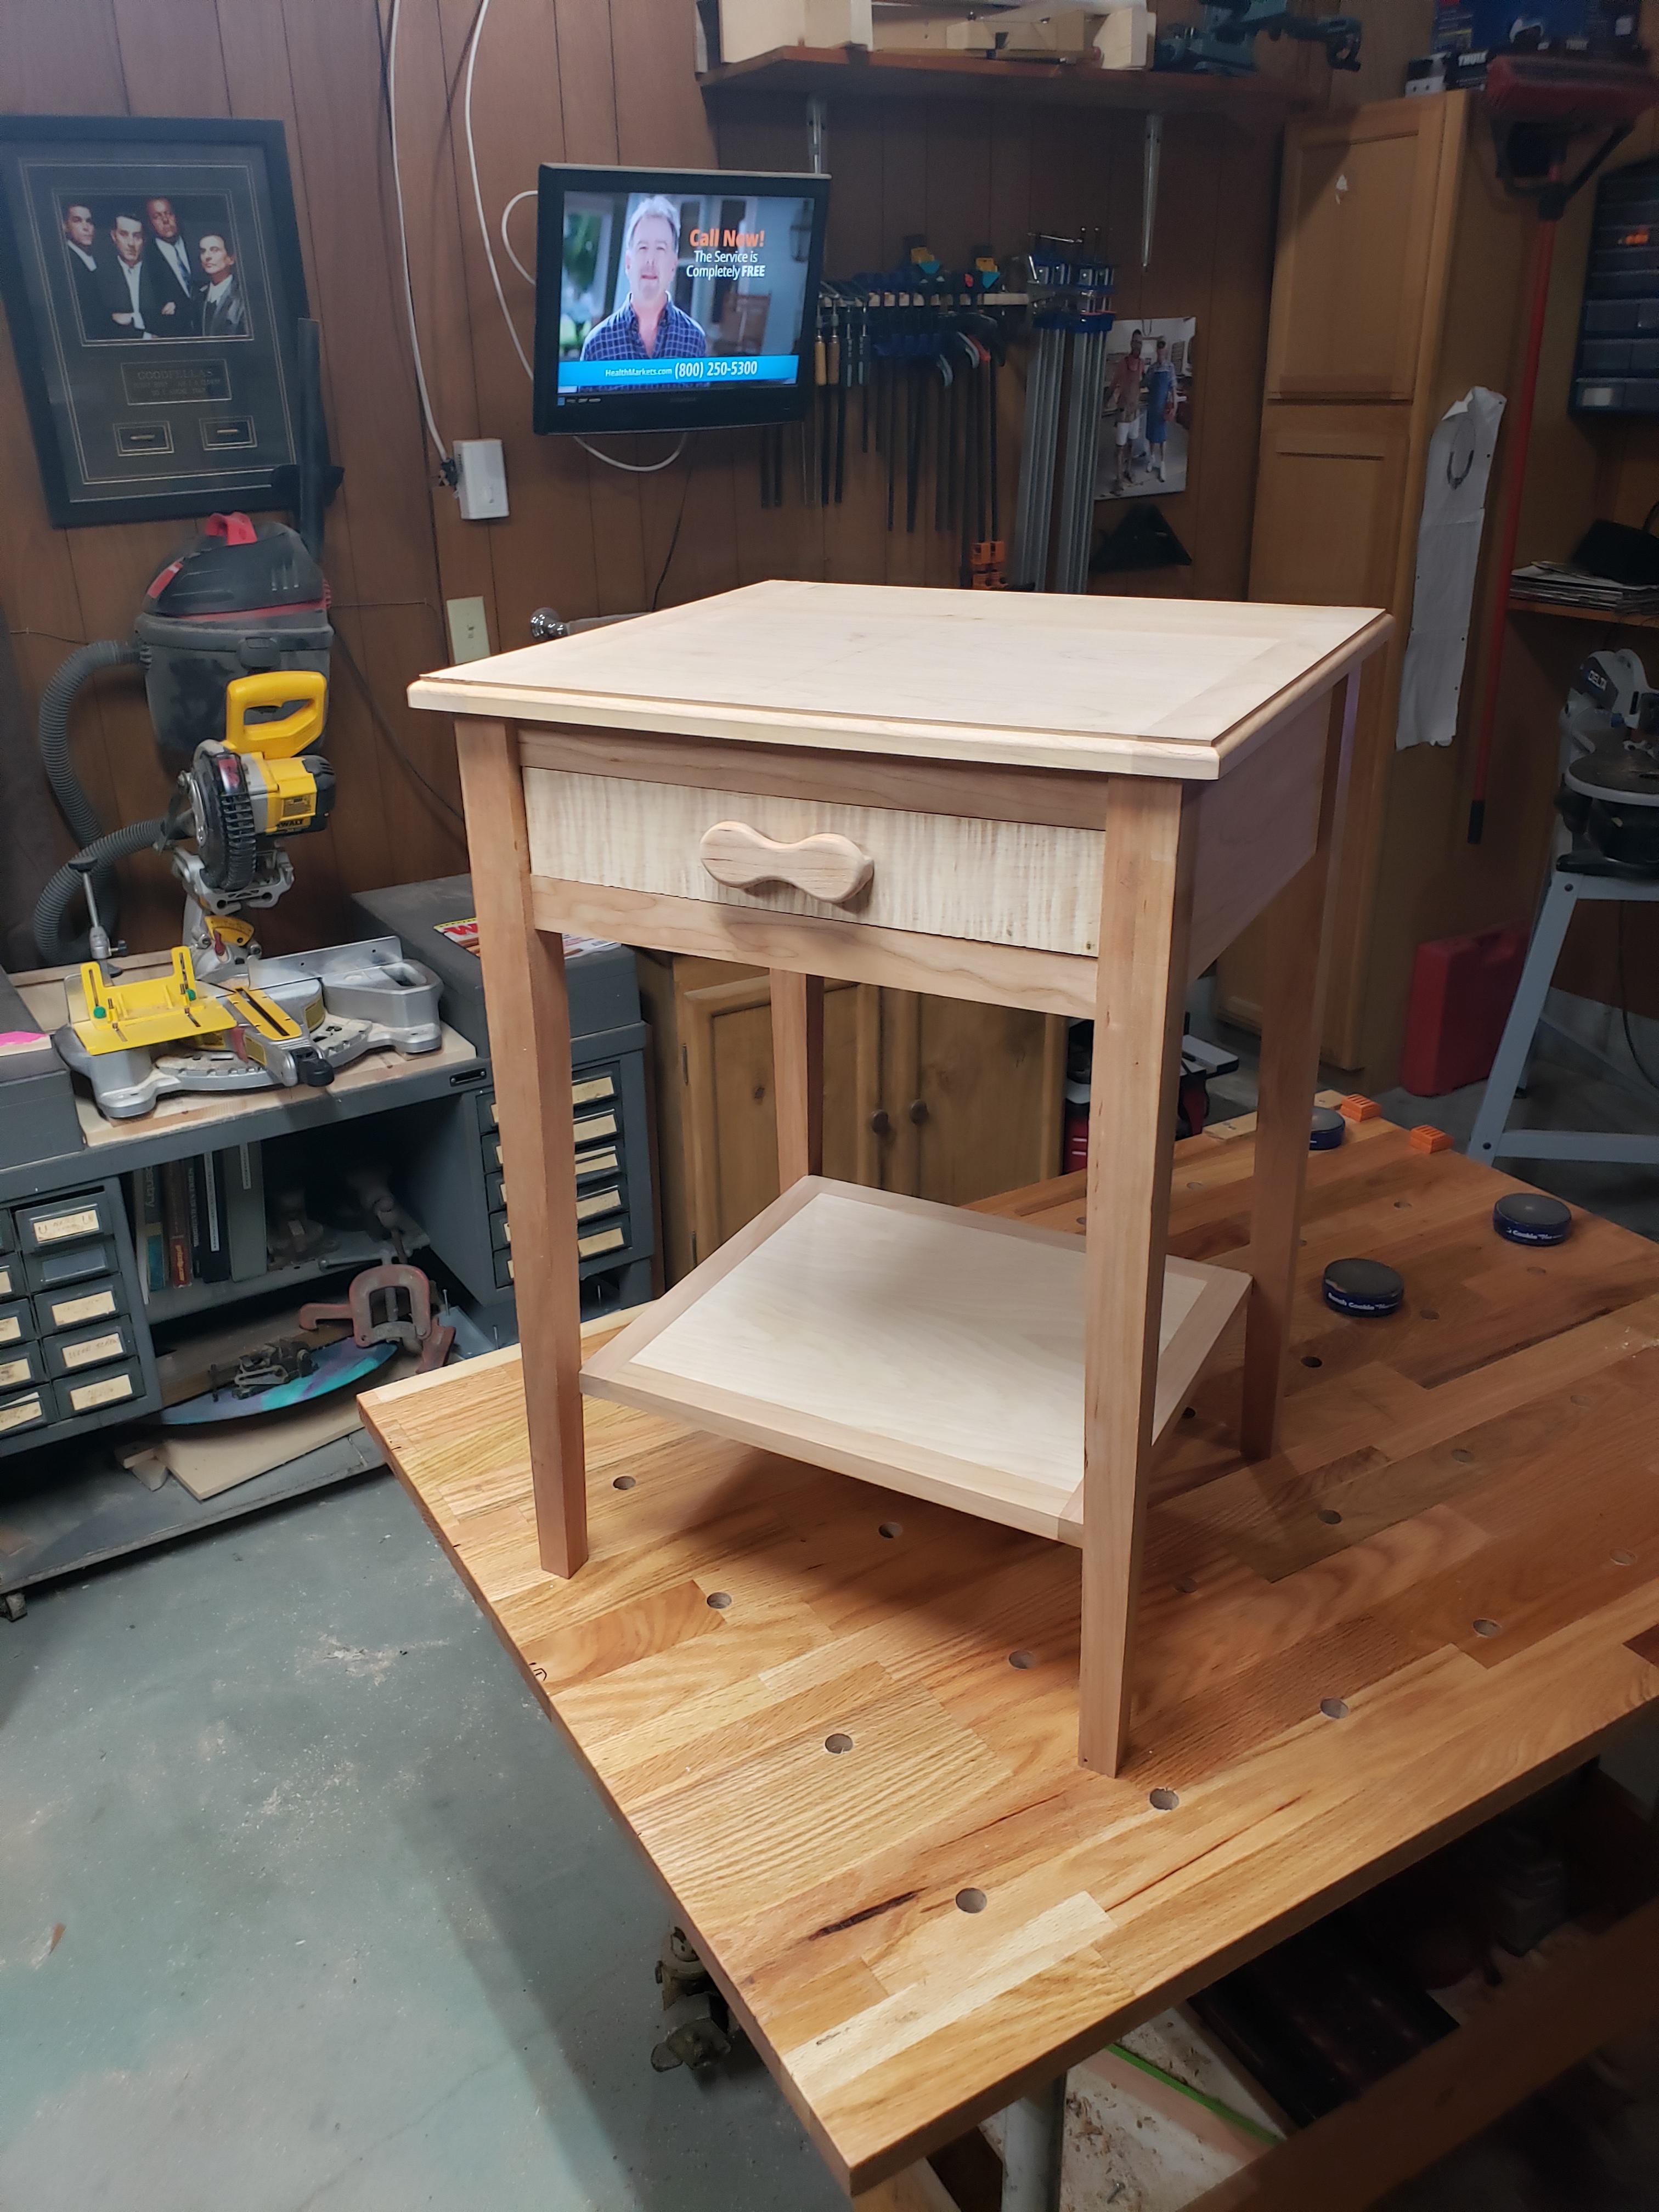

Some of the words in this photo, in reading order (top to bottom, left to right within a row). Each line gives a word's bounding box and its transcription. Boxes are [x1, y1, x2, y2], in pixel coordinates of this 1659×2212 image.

[690, 228, 720, 247] Call
[723, 229, 765, 247] Now!
[693, 250, 712, 263] The
[714, 250, 748, 263] Service
[750, 250, 758, 263] is
[686, 264, 741, 281] Completely
[742, 265, 766, 277] FREE
[674, 362, 704, 379] (800)
[707, 360, 758, 376] 250-5300
